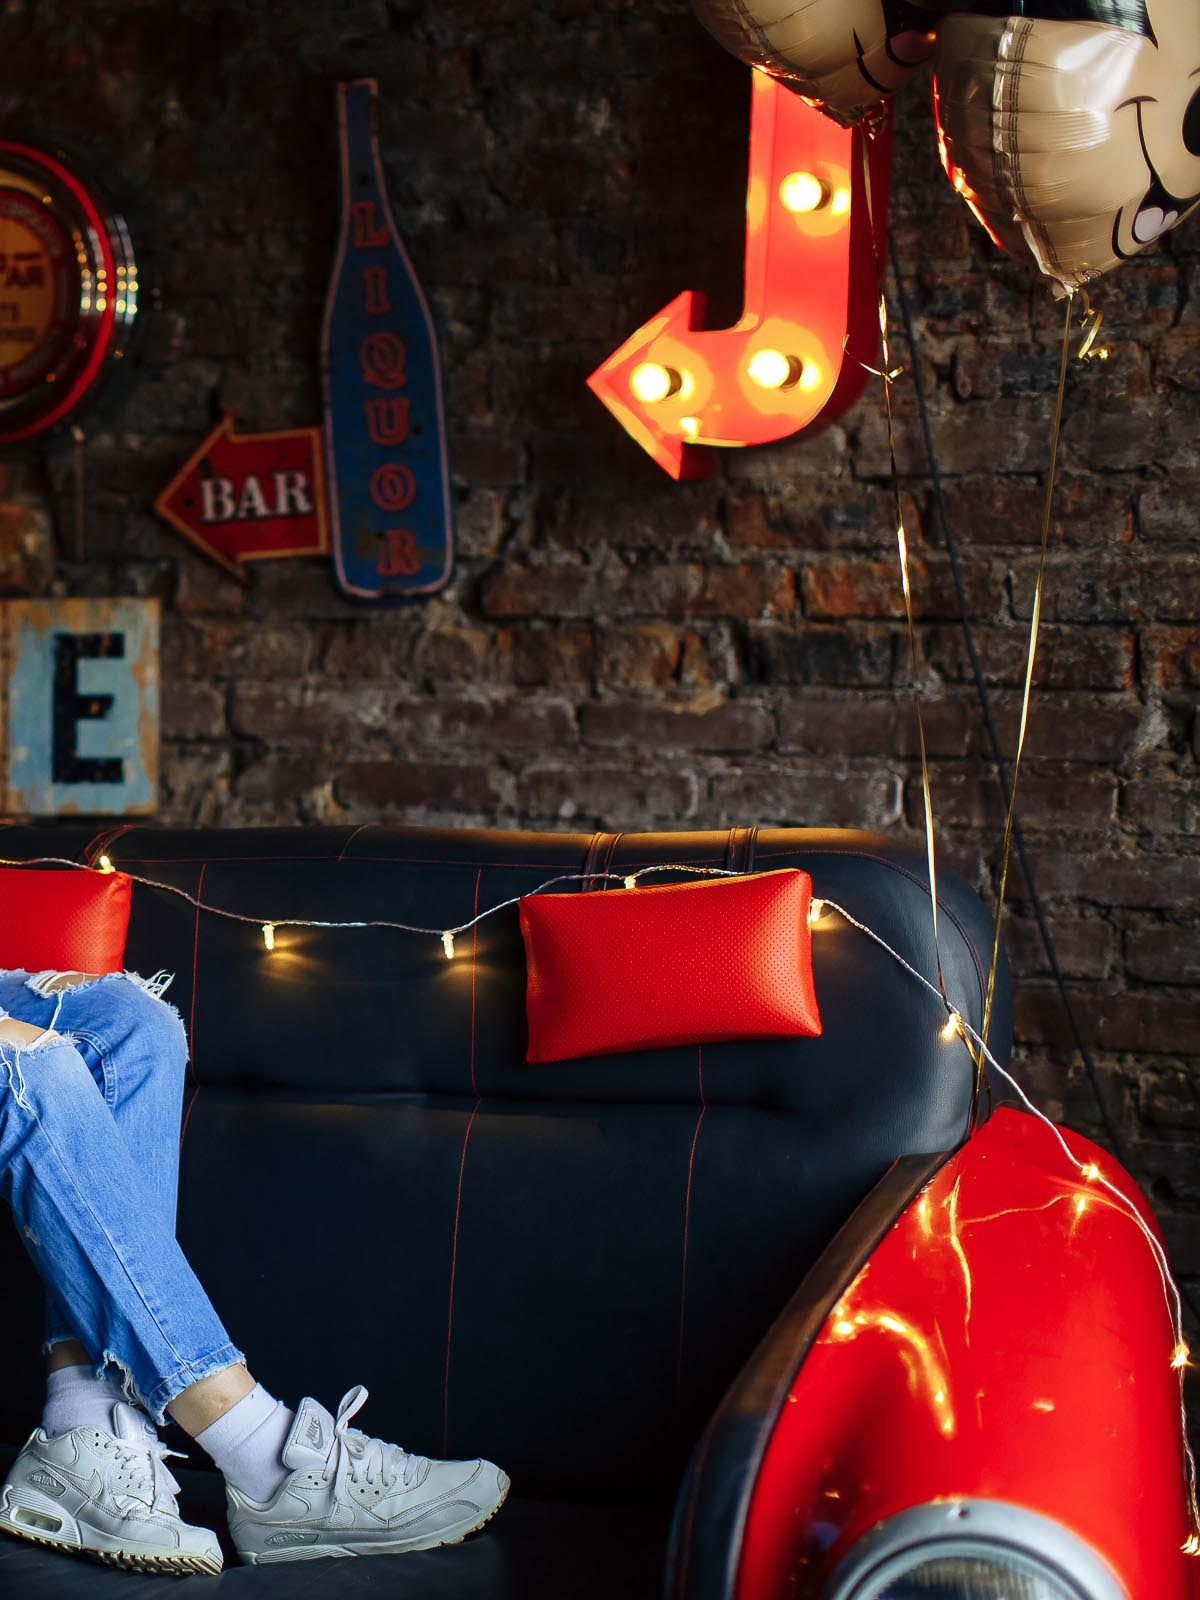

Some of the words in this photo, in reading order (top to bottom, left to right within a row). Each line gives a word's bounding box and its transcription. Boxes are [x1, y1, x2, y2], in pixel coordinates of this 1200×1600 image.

[351, 201, 421, 576] LIQUOR
[200, 470, 313, 521] BAR
[53, 632, 125, 784] E
[305, 1416, 321, 1442] NIKE
